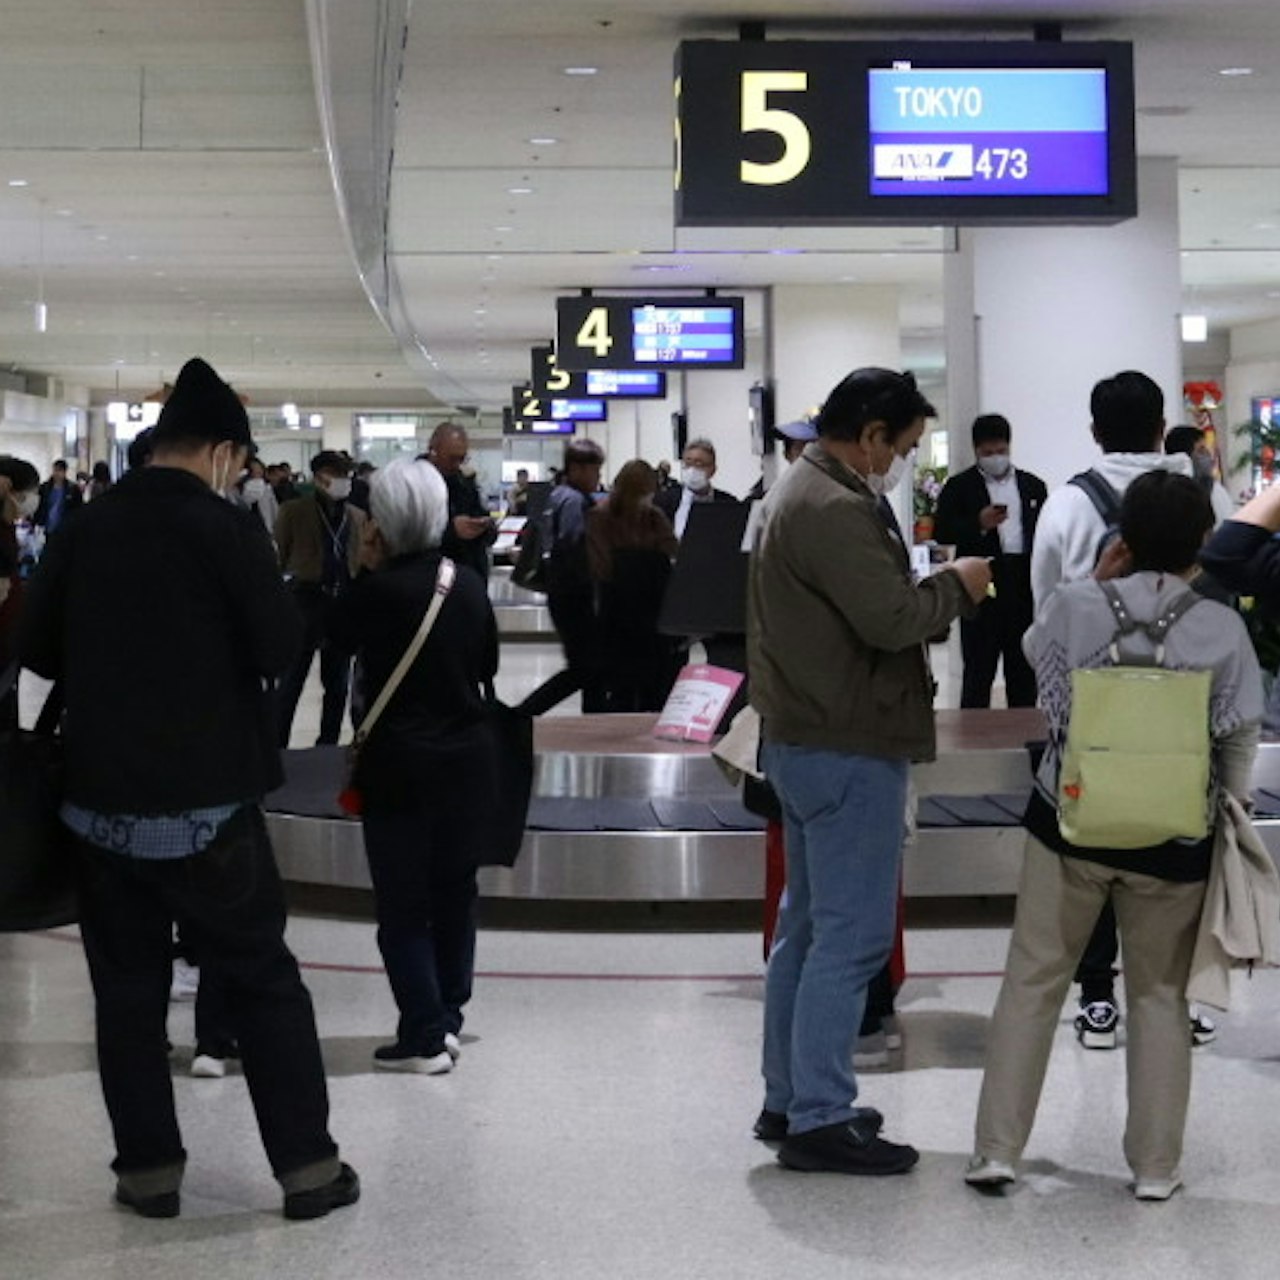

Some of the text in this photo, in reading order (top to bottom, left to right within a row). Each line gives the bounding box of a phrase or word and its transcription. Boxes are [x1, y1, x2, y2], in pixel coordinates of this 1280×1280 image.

[895, 86, 983, 118] TOKYO
[739, 70, 812, 186] 5
[891, 147, 1029, 180] ANA 473
[575, 306, 613, 357] 4
[522, 389, 542, 417] 2
